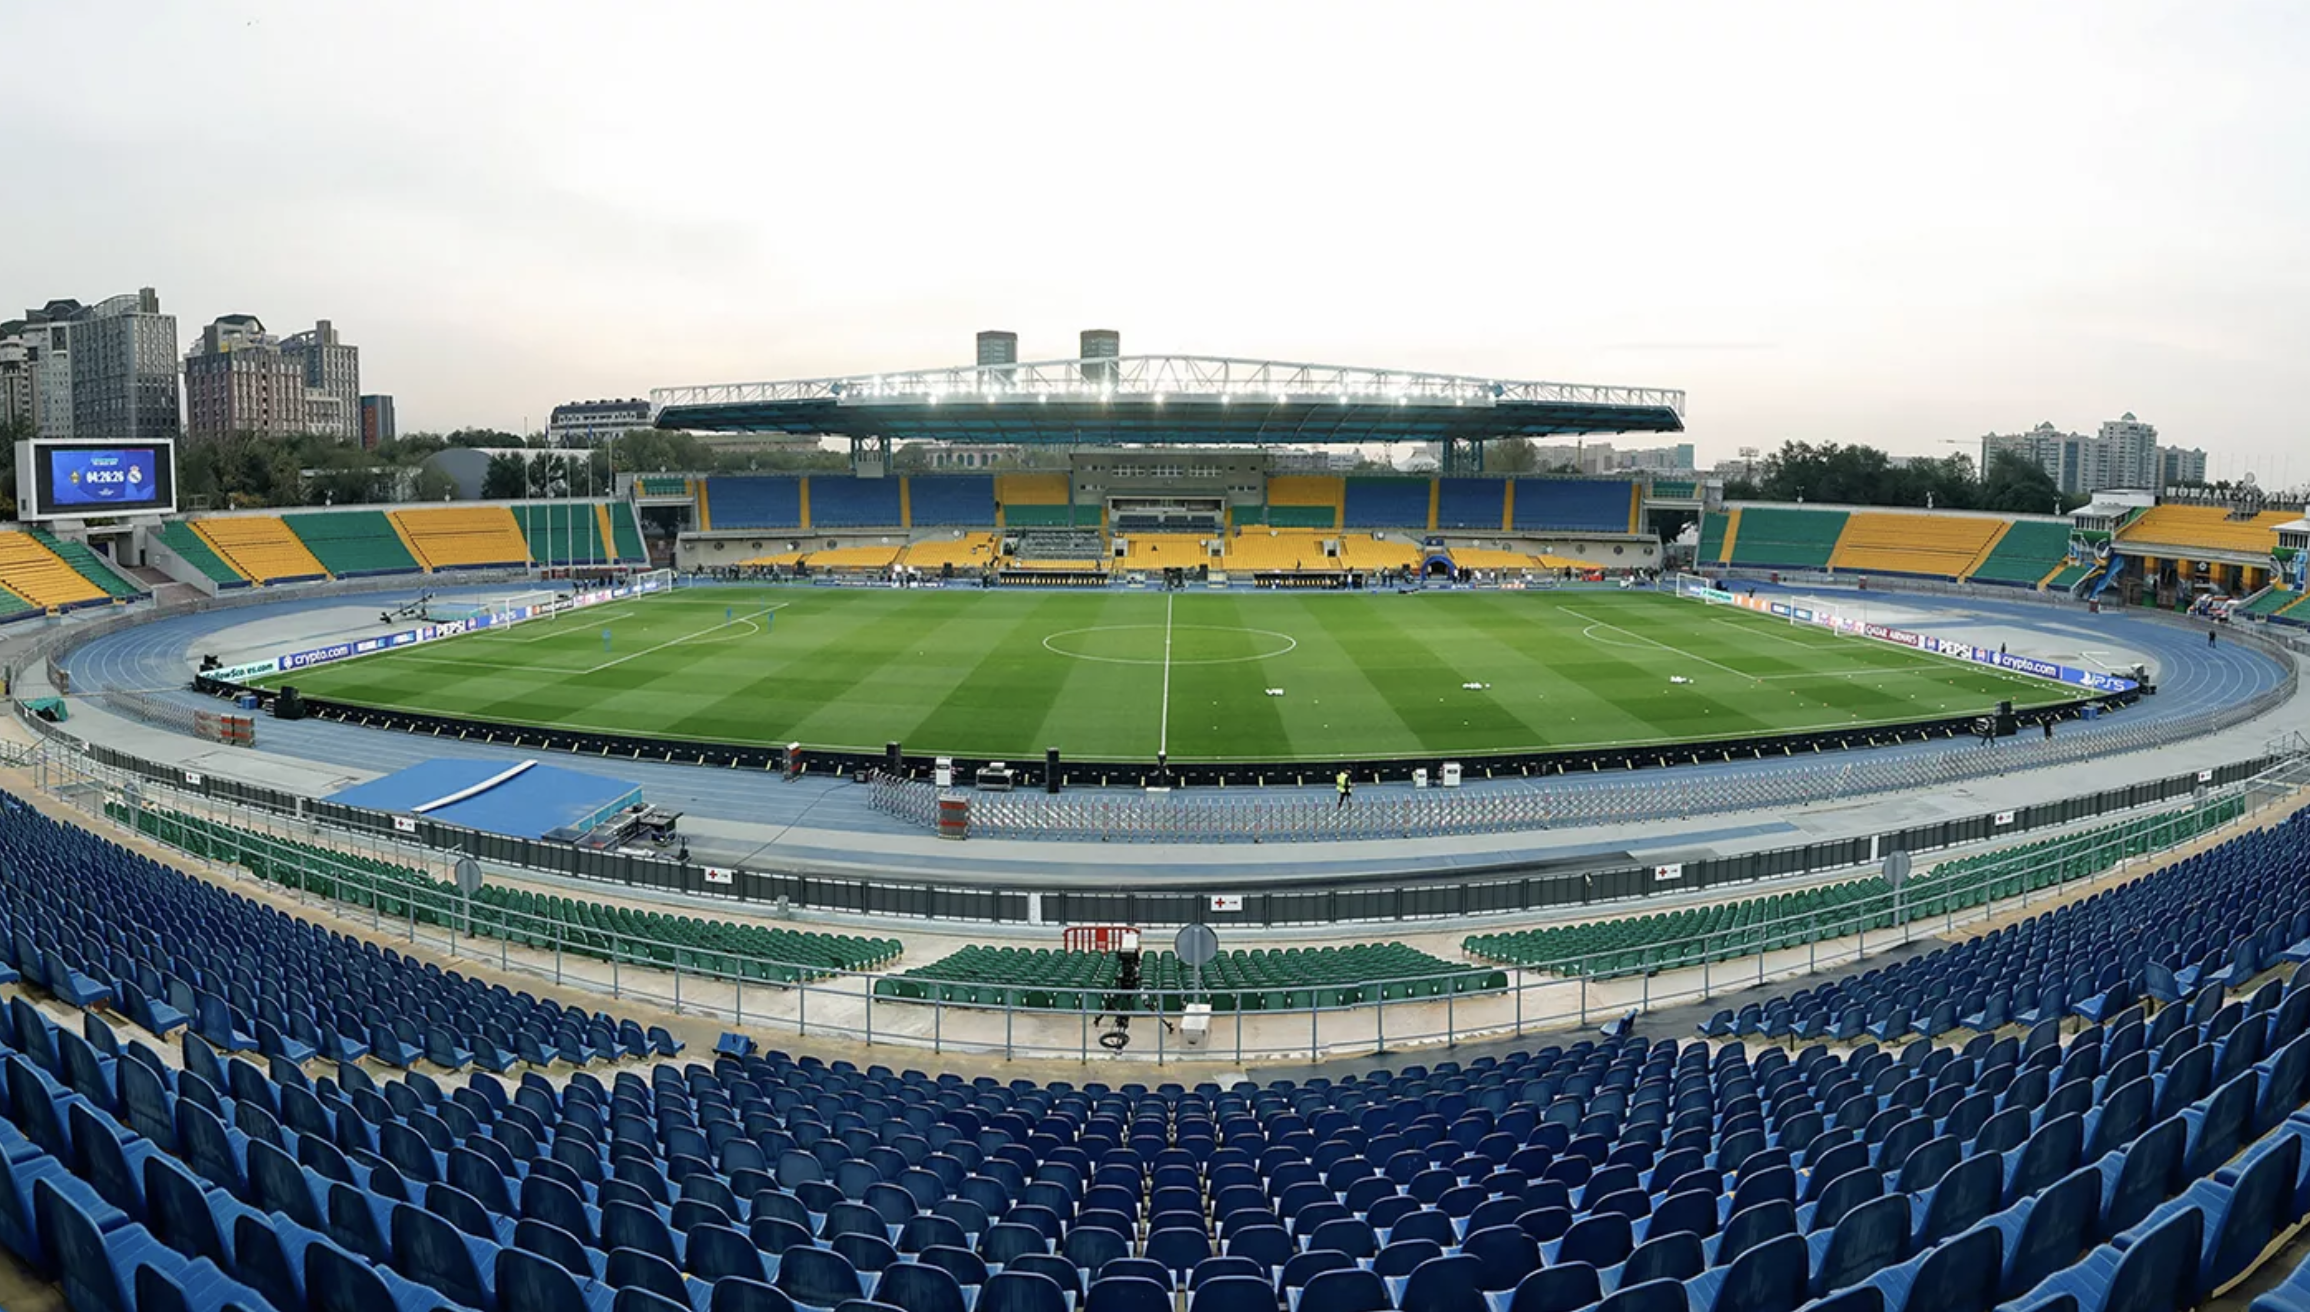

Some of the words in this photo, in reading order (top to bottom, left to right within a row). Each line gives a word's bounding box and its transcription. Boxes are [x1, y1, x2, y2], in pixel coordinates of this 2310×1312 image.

[436, 620, 465, 637] PEPSI
[1866, 625, 1888, 637] QATAR
[295, 646, 347, 666] crypto.com
[1939, 639, 1972, 658] PEPSI
[2002, 655, 2056, 676] crypto.com
[2094, 677, 2125, 691] PS5
